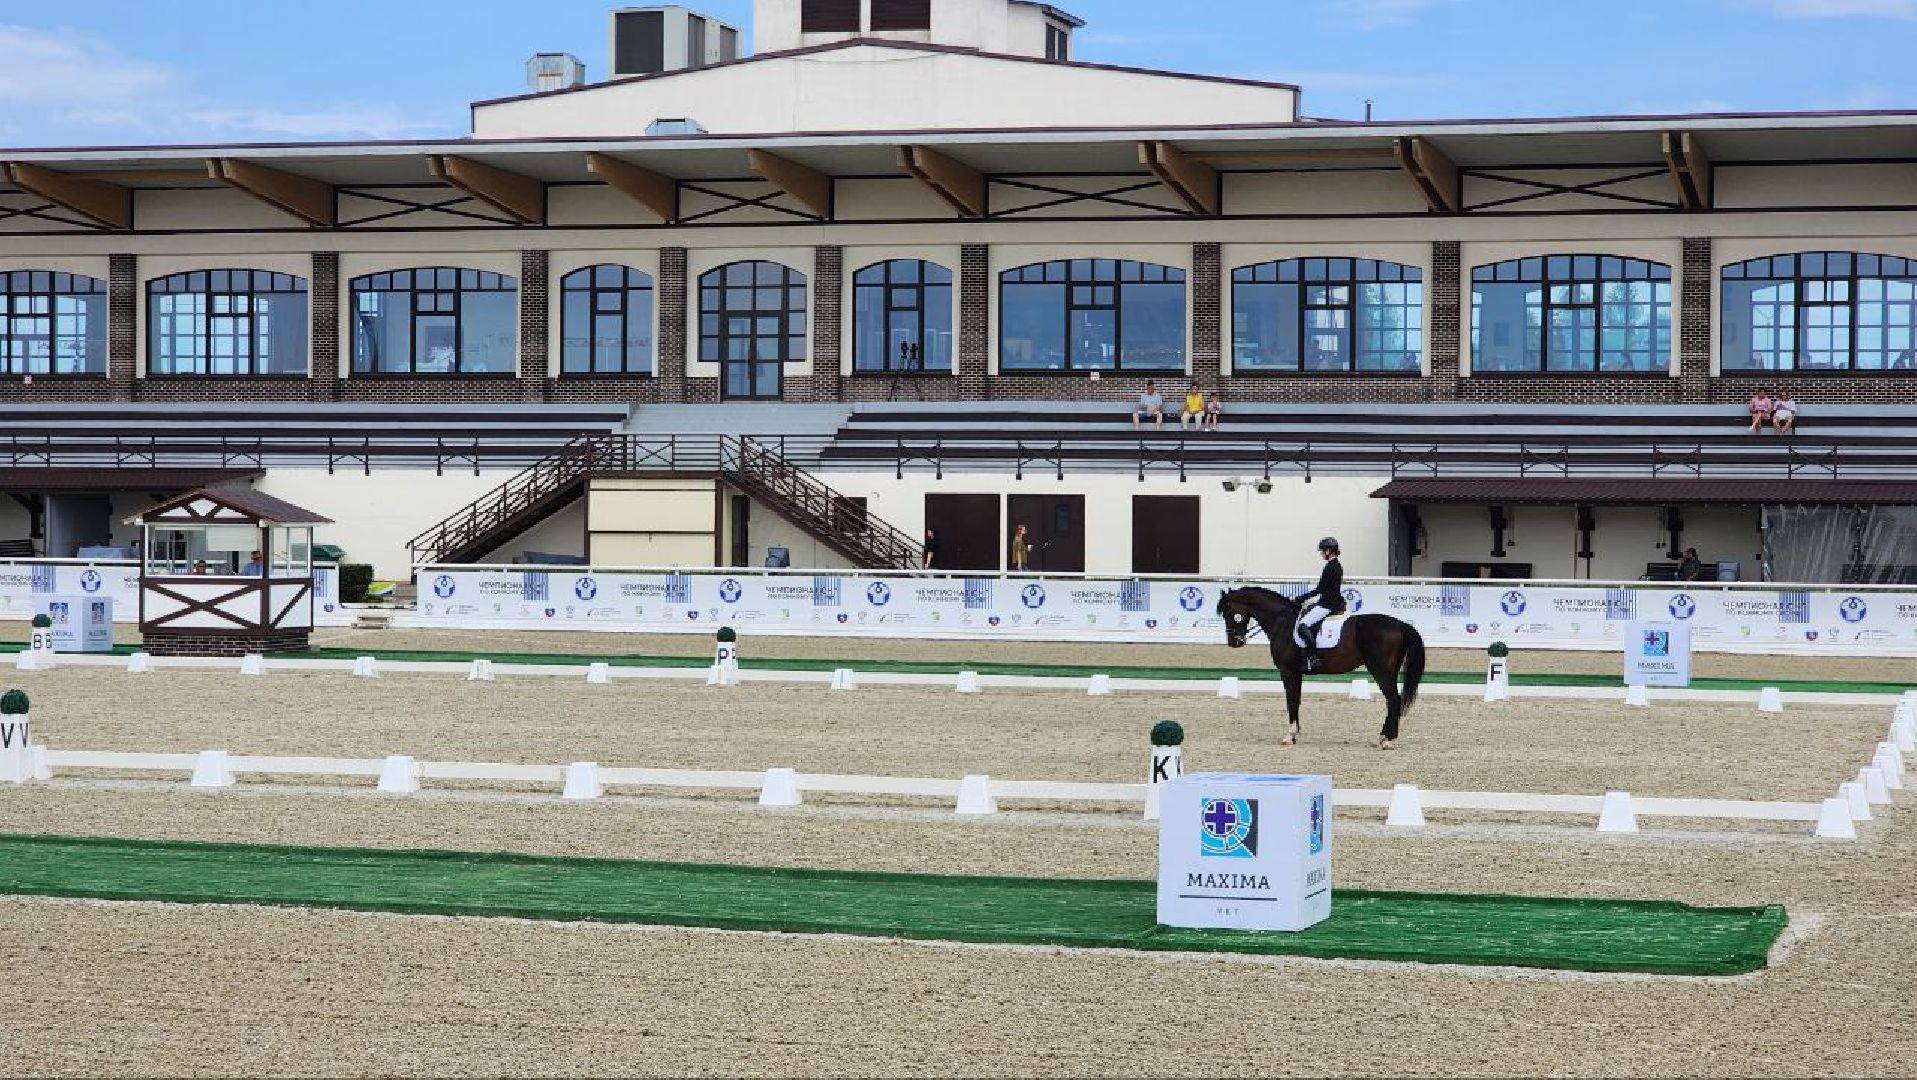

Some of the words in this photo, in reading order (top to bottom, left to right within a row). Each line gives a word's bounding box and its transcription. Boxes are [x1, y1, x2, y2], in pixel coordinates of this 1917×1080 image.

[34, 633, 42, 649] B
[718, 648, 729, 665] P
[1491, 663, 1503, 681] F
[0, 723, 14, 749] V
[1153, 755, 1171, 783] K
[1187, 873, 1271, 889] MAXIMA
